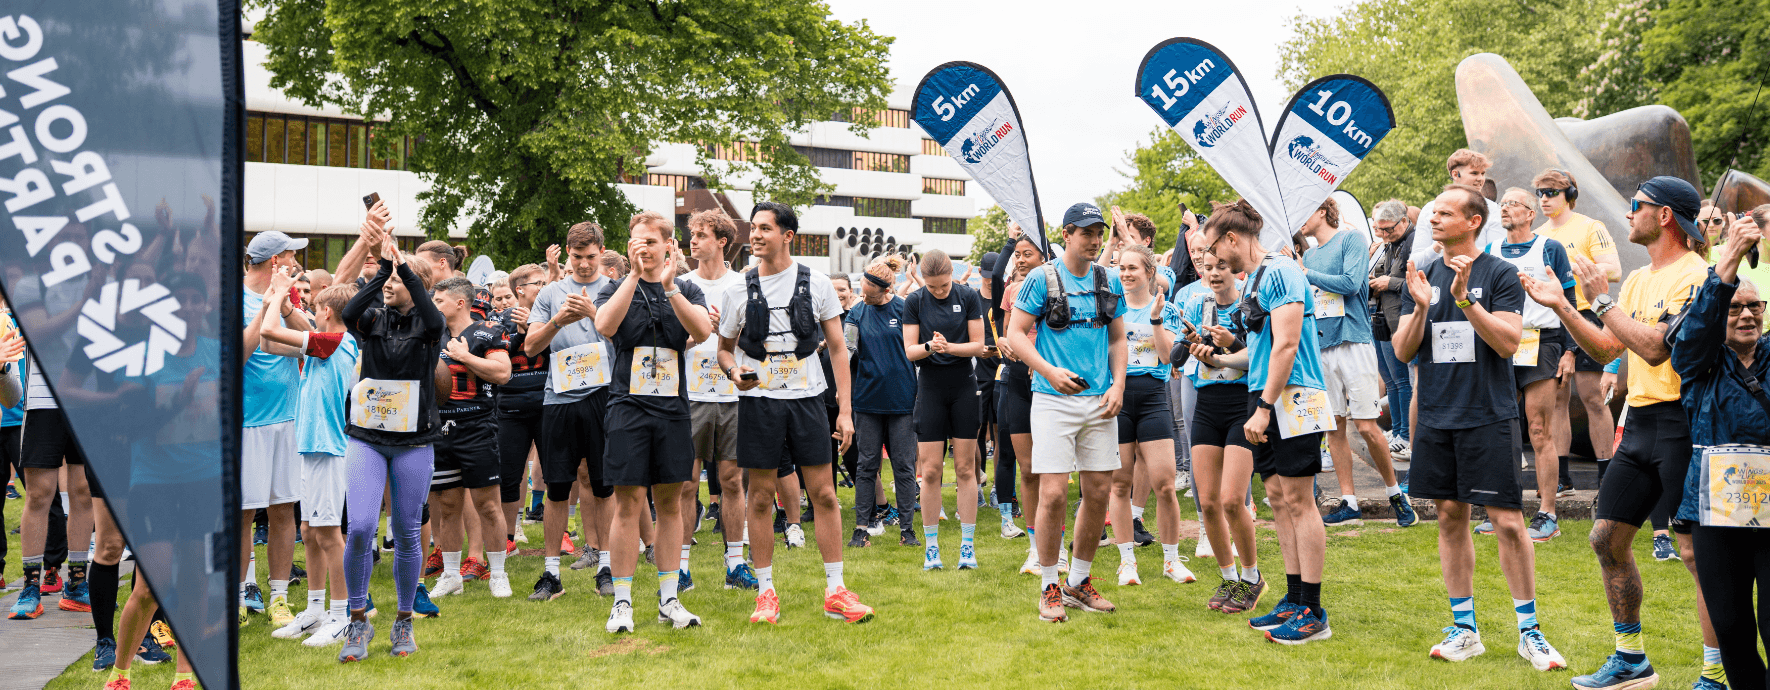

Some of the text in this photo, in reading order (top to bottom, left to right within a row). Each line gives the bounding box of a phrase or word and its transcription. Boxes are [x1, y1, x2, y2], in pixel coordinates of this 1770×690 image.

[1442, 342, 1464, 350] 81398
[769, 367, 798, 375] 153976
[641, 371, 671, 381] 16136
[700, 372, 726, 381] 246756
[367, 404, 398, 415] 181063
[1726, 492, 1770, 504] 23912
